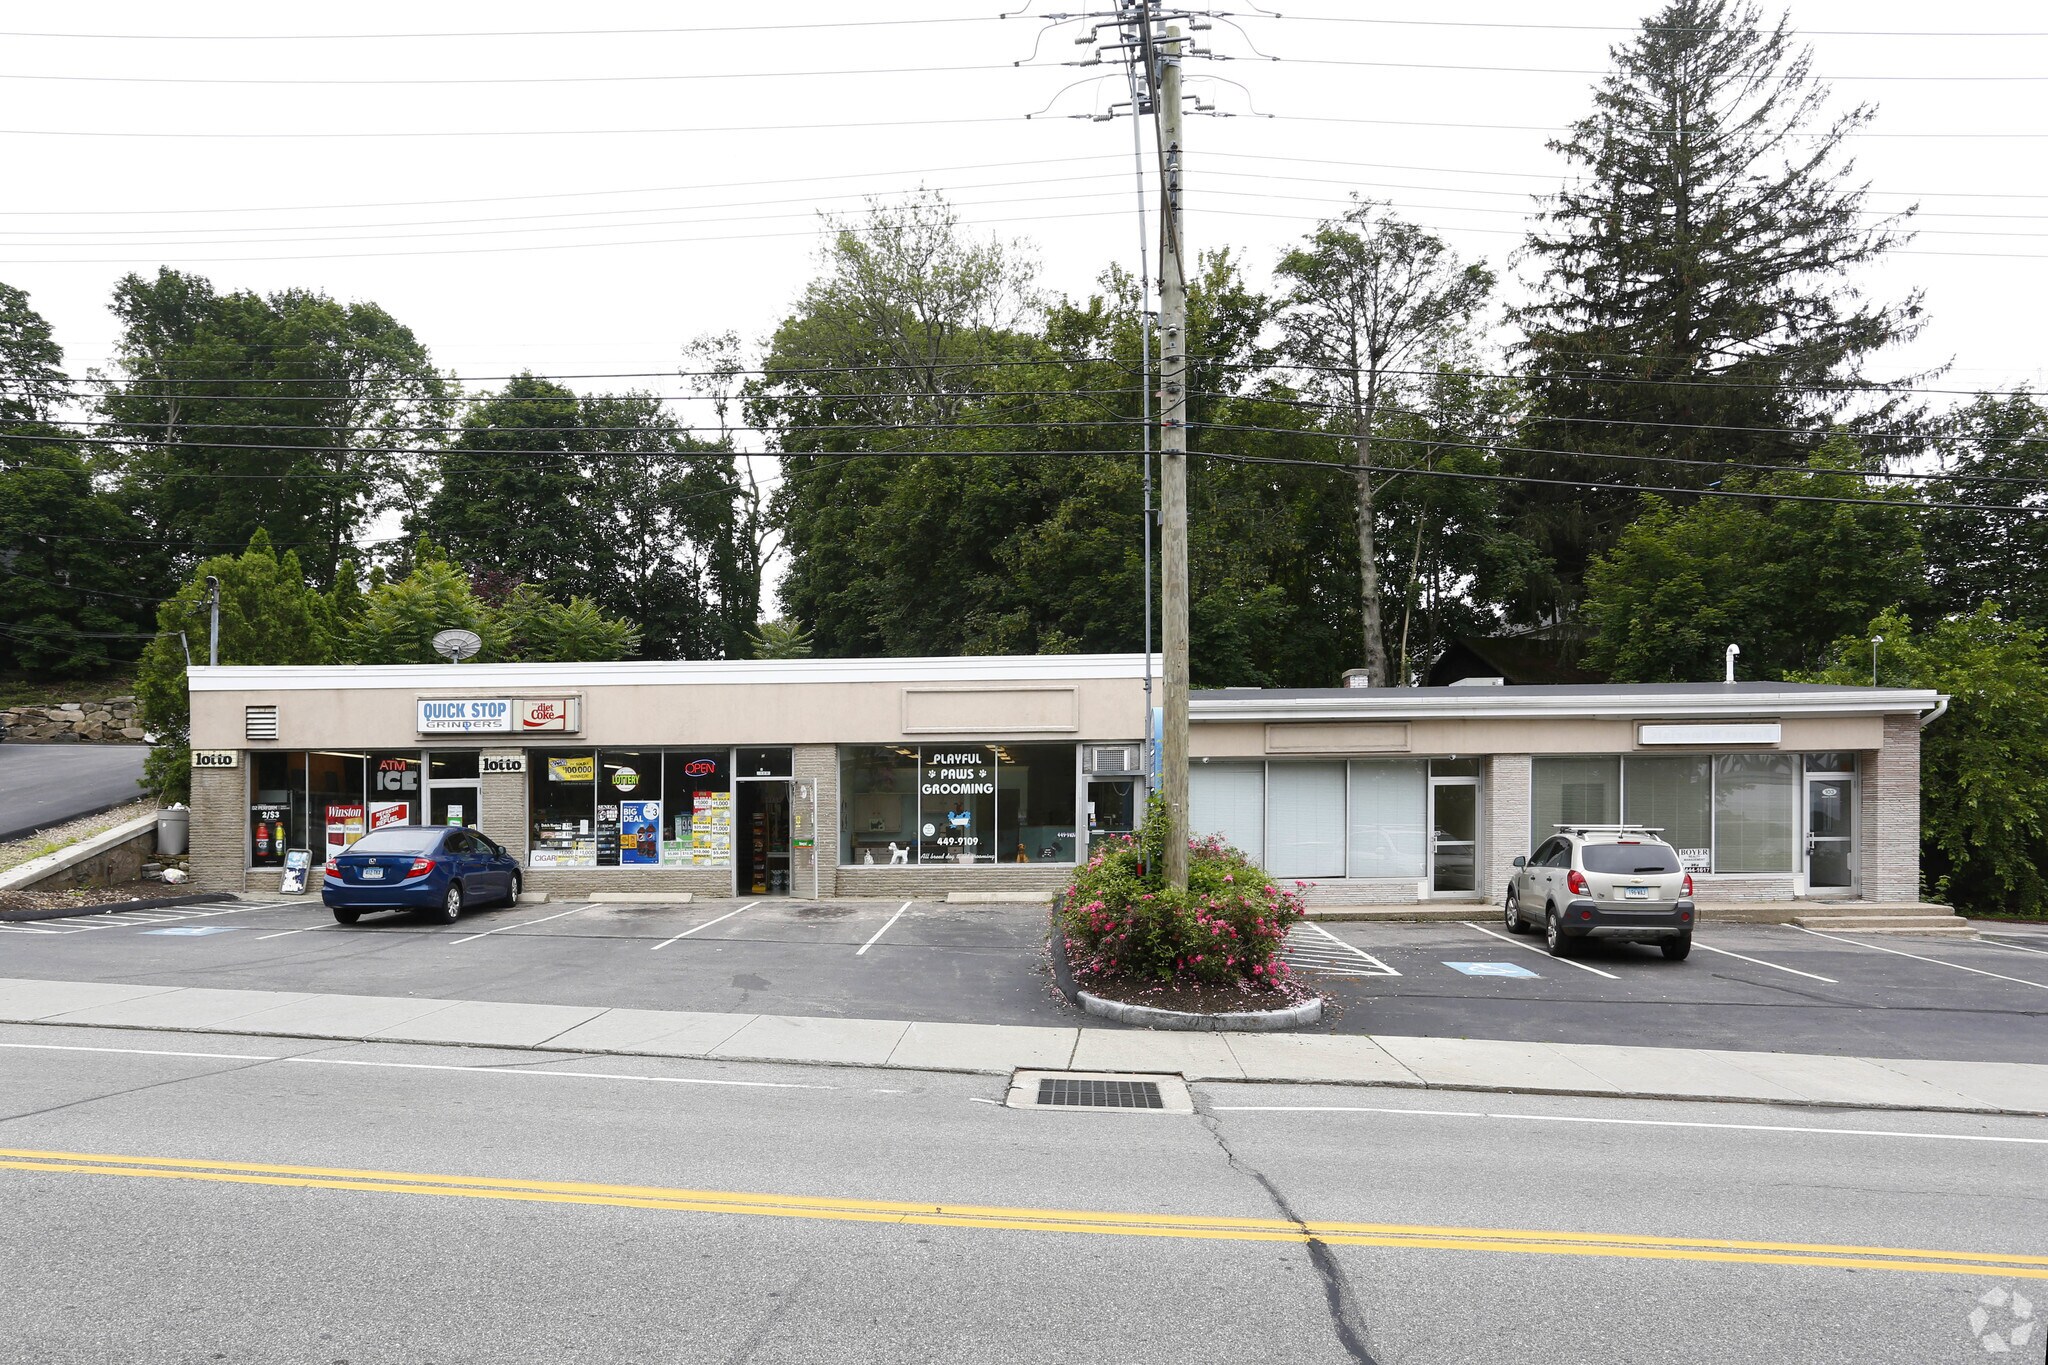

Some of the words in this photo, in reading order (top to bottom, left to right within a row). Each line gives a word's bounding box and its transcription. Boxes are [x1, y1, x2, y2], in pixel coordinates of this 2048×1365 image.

[423, 703, 466, 721] QUICK
[471, 702, 507, 718] STOP
[538, 703, 554, 711] diet
[531, 709, 555, 720] Coke
[195, 753, 233, 765] lotto
[483, 757, 522, 771] lotto
[933, 753, 982, 764] PLAYFUL
[379, 760, 406, 771] ATM
[685, 763, 715, 774] OPEN
[940, 768, 974, 780] PAWS
[376, 770, 418, 791] ICE
[612, 774, 640, 786] LOTTERY
[921, 783, 994, 795] GROOMING
[261, 811, 280, 820] 2/$3
[328, 806, 362, 818] Winston
[623, 808, 638, 816] BIG
[652, 808, 658, 817] 3
[376, 814, 400, 828] REFUEL
[623, 815, 644, 823] DEAL
[258, 841, 268, 849] G2
[275, 840, 283, 849] G
[937, 837, 979, 846] 449-9109
